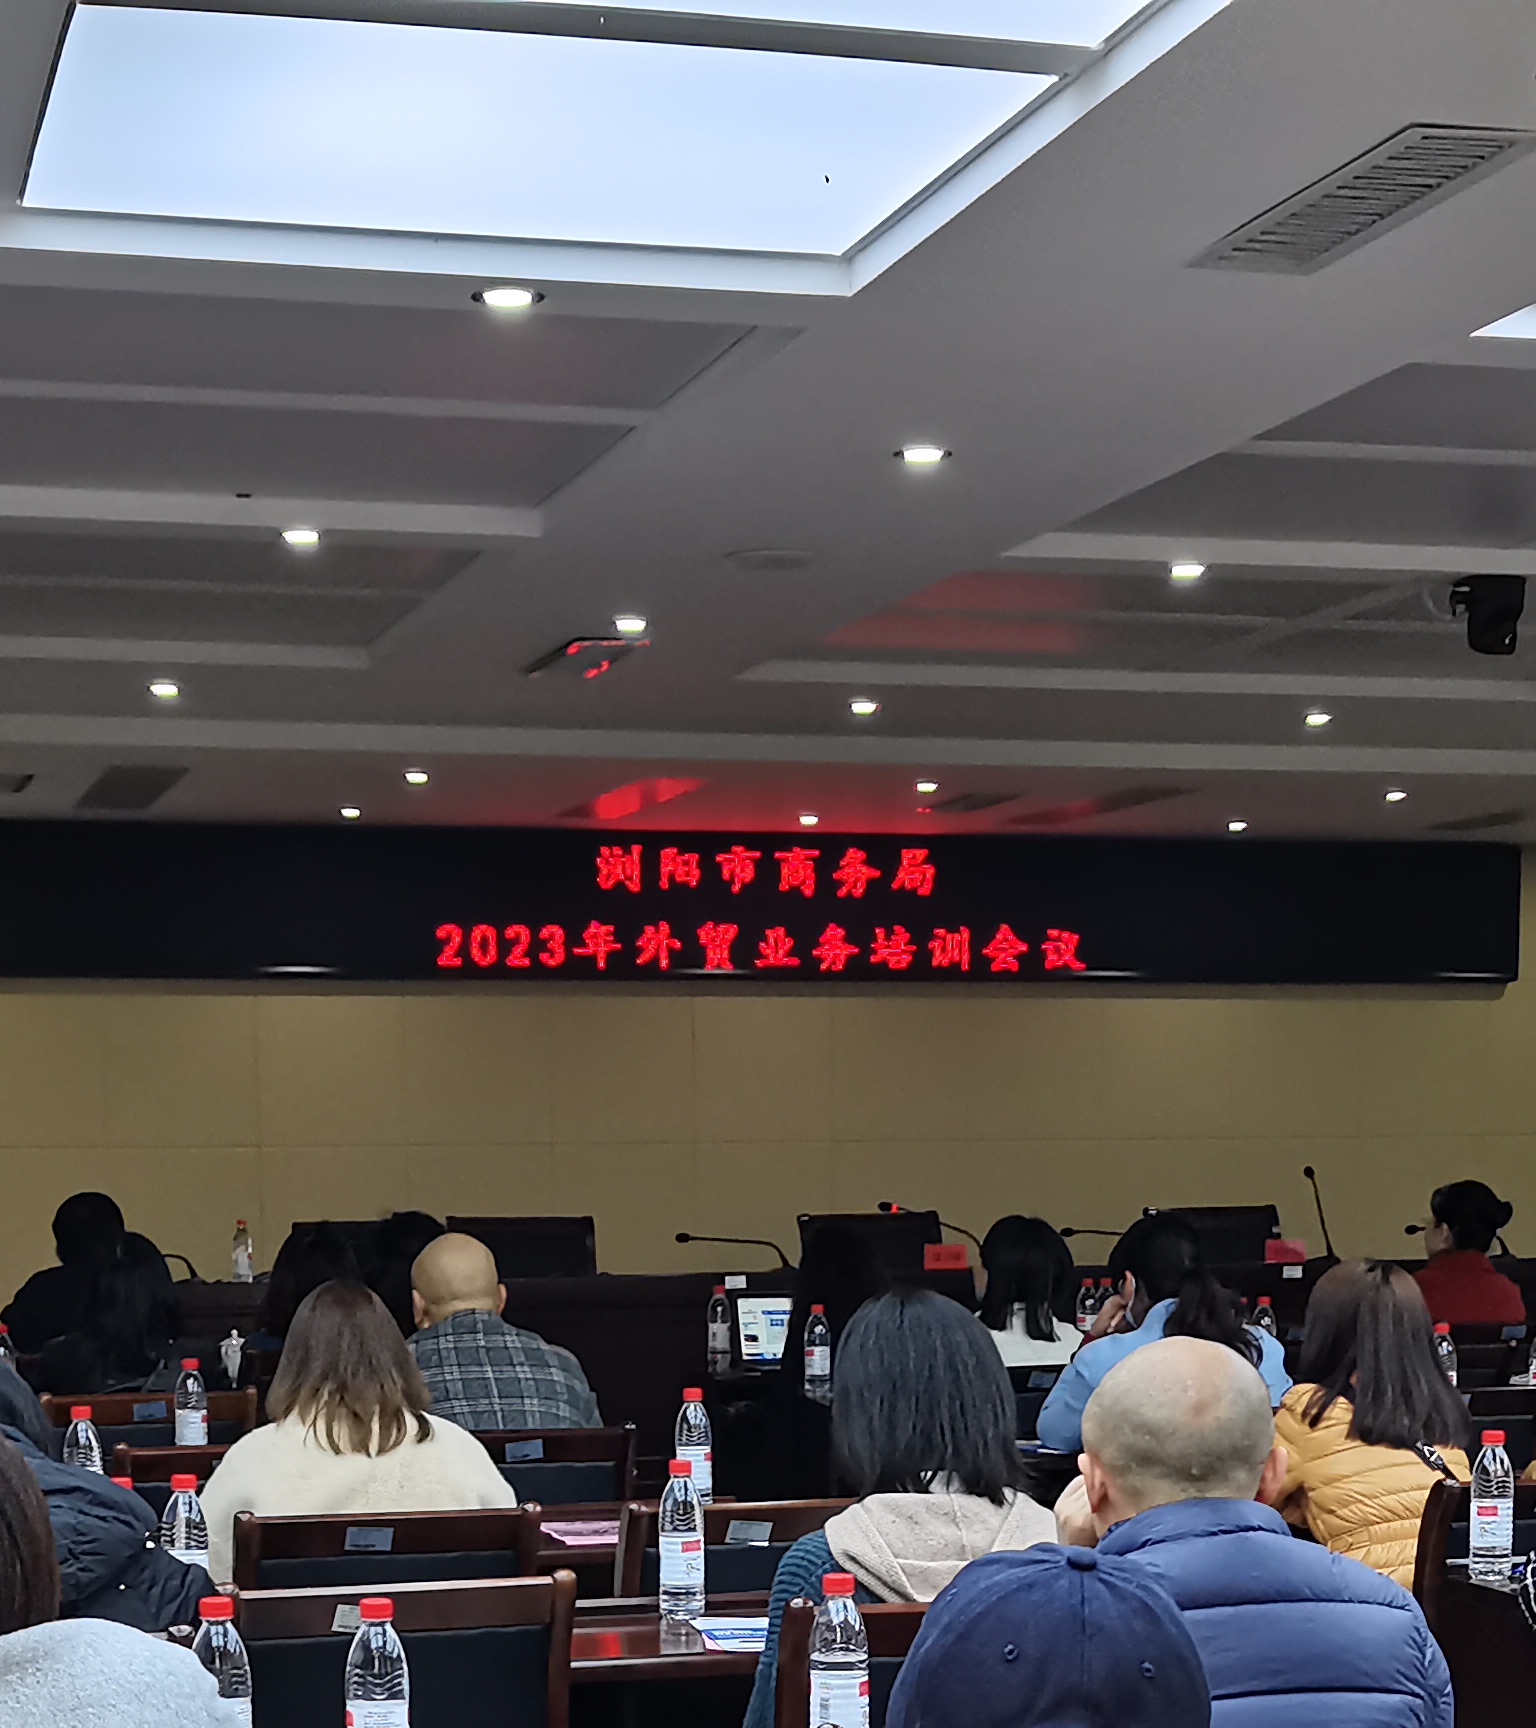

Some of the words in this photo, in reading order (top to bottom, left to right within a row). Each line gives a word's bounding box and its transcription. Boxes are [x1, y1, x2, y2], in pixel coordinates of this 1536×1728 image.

[596, 845, 936, 896] 浏阳市商务局
[435, 920, 1086, 971] 2023年外贸业务培训会议
